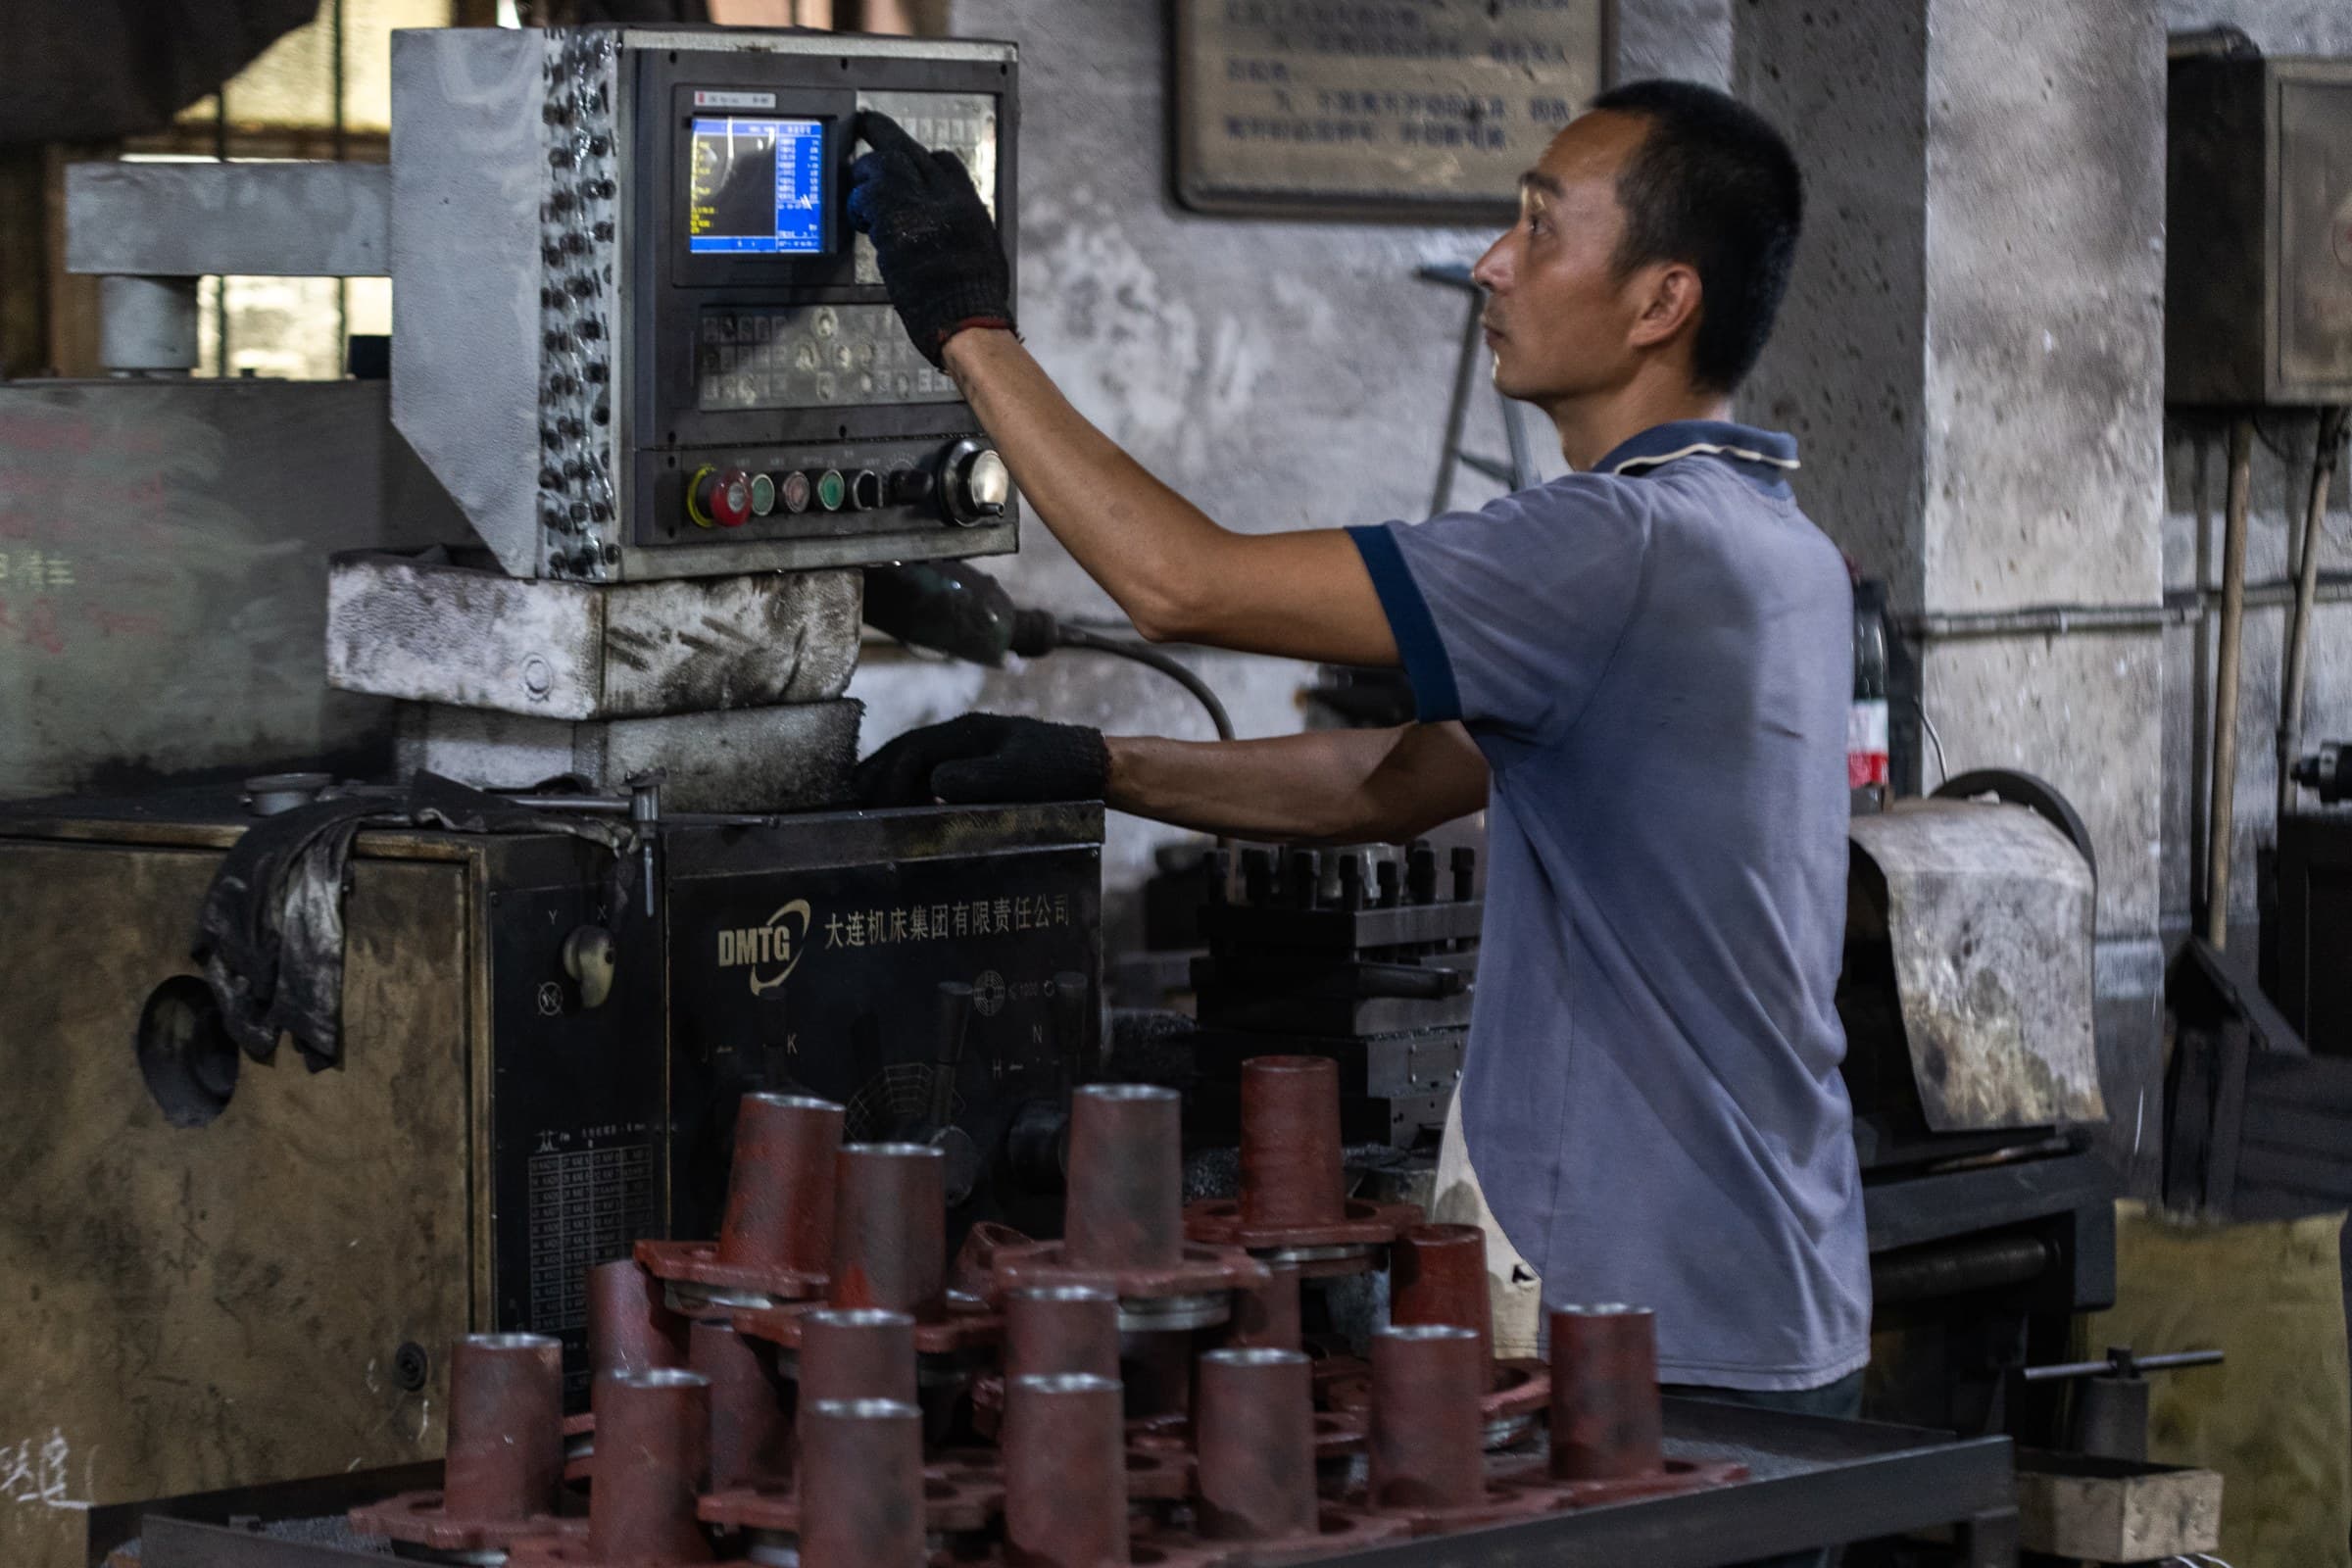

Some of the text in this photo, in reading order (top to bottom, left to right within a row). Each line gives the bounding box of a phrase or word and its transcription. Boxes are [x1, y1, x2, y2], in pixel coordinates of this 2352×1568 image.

[548, 908, 558, 925] Y
[824, 894, 1070, 950] 大连机床集团有限责任公司
[717, 924, 791, 967] DMTG
[787, 1032, 798, 1055] K
[1032, 1023, 1043, 1044] N
